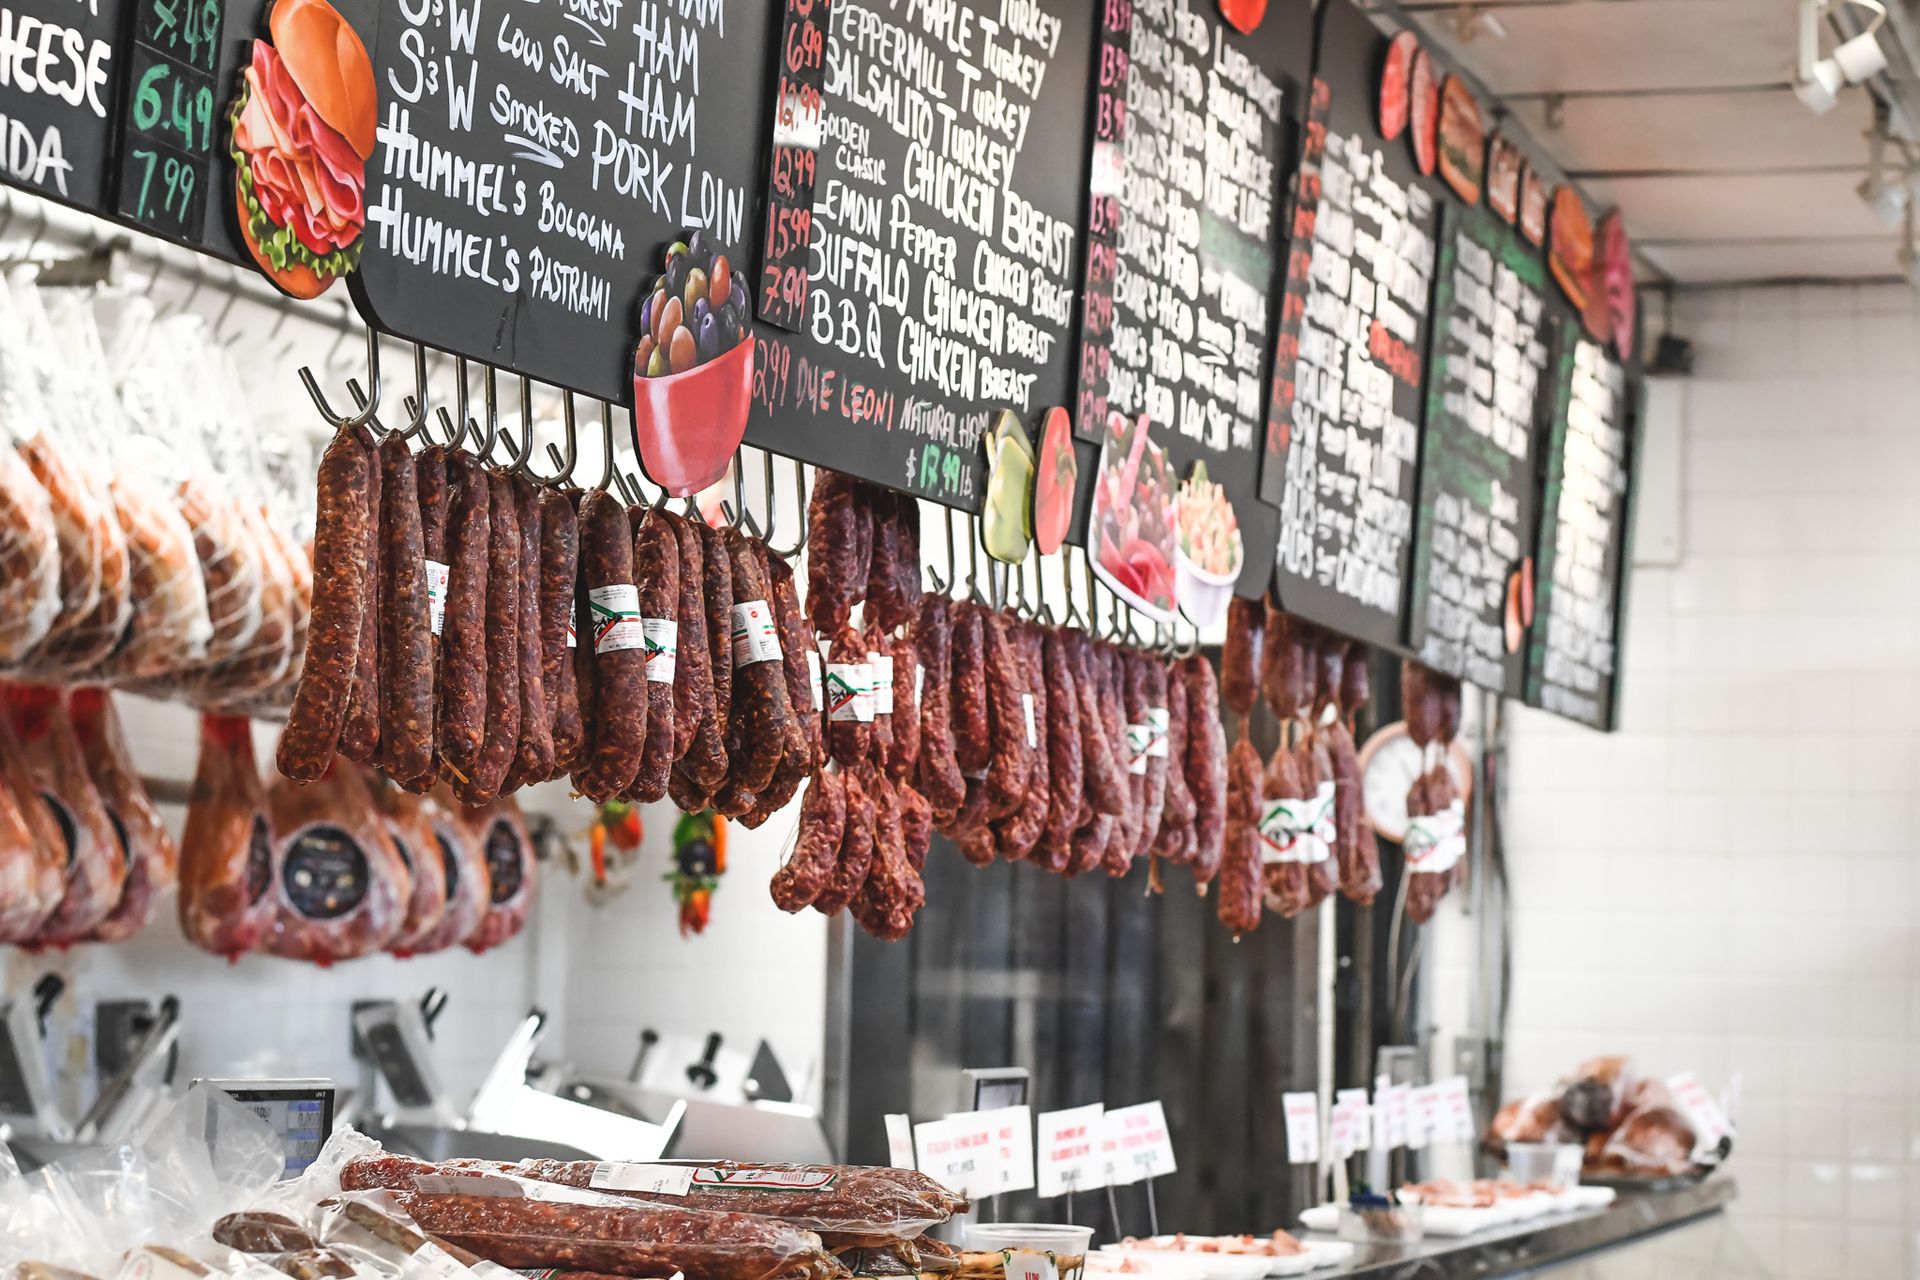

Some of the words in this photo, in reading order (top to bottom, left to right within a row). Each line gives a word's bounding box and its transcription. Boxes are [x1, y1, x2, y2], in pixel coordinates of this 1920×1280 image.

[498, 13, 543, 73] LOW
[550, 35, 610, 101] SALT
[618, 62, 698, 157] HAM
[633, 0, 698, 96] HAM
[828, 0, 947, 99] PEPPERMILL
[956, 58, 1031, 153] TURKEY
[979, 16, 1046, 100] TURKEY
[133, 64, 213, 151] 6.49
[936, 102, 1016, 197] TURKEY
[132, 150, 196, 224] 7.99
[376, 102, 526, 216] HUMMEL'S
[538, 181, 624, 260] BOLOGNA
[490, 84, 579, 157] SMOKED
[592, 120, 673, 223] PORK
[681, 163, 744, 247] LOIN
[835, 145, 887, 186] CLASSIC
[903, 141, 995, 237] CHICKEN
[1002, 190, 1075, 280] BREAST
[367, 184, 520, 292] HUMMEL'S
[529, 246, 611, 321] PASTRAMI
[767, 202, 811, 260] 15.99
[890, 194, 956, 280] PEPPER
[763, 264, 808, 333] 7.99
[808, 218, 910, 316] BUFFALO
[923, 270, 1004, 356] CHICKEN
[1007, 312, 1056, 364] BREAST
[898, 316, 976, 400] CHICKEN
[979, 356, 1038, 414] BREAST
